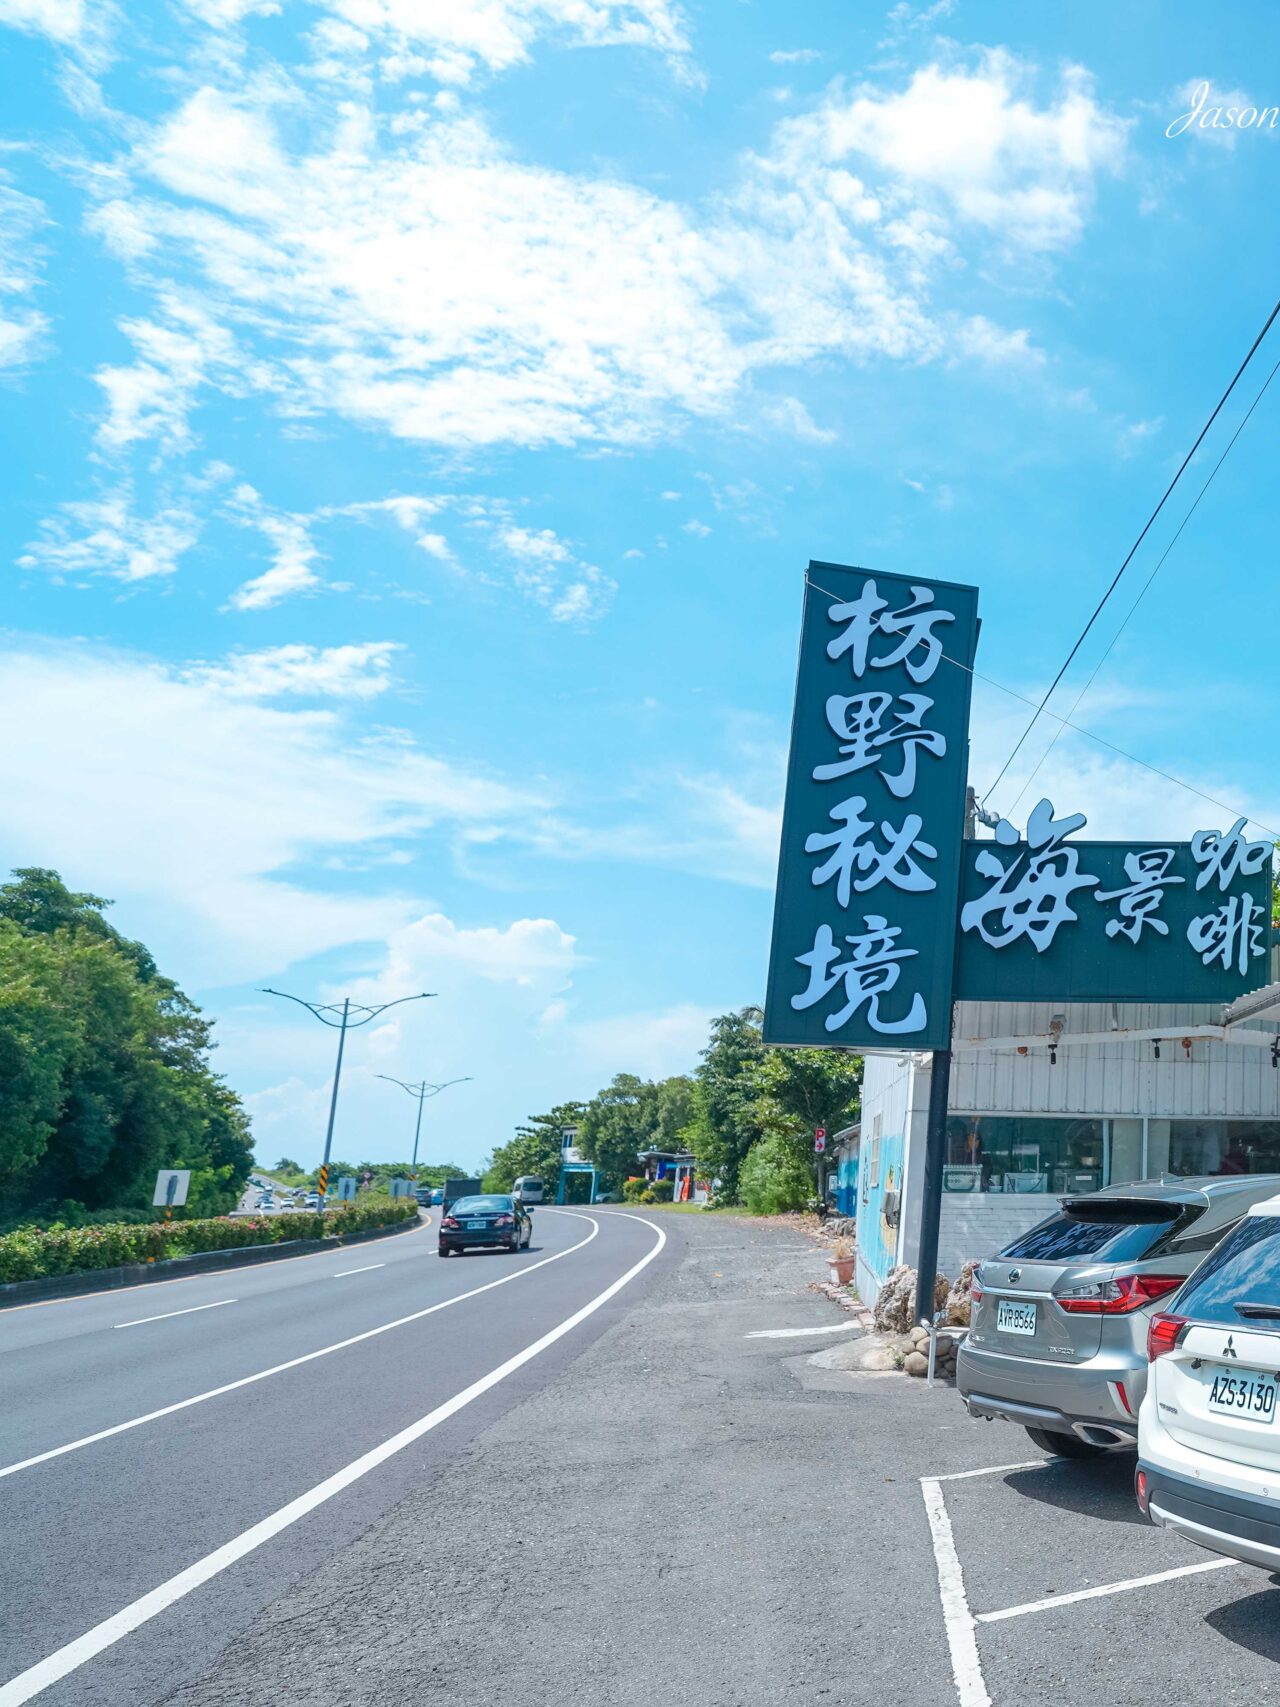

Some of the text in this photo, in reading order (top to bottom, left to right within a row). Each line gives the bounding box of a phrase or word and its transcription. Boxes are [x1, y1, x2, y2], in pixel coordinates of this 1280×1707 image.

[790, 578, 956, 1035] 枋野秘境
[816, 1130, 825, 1140] P
